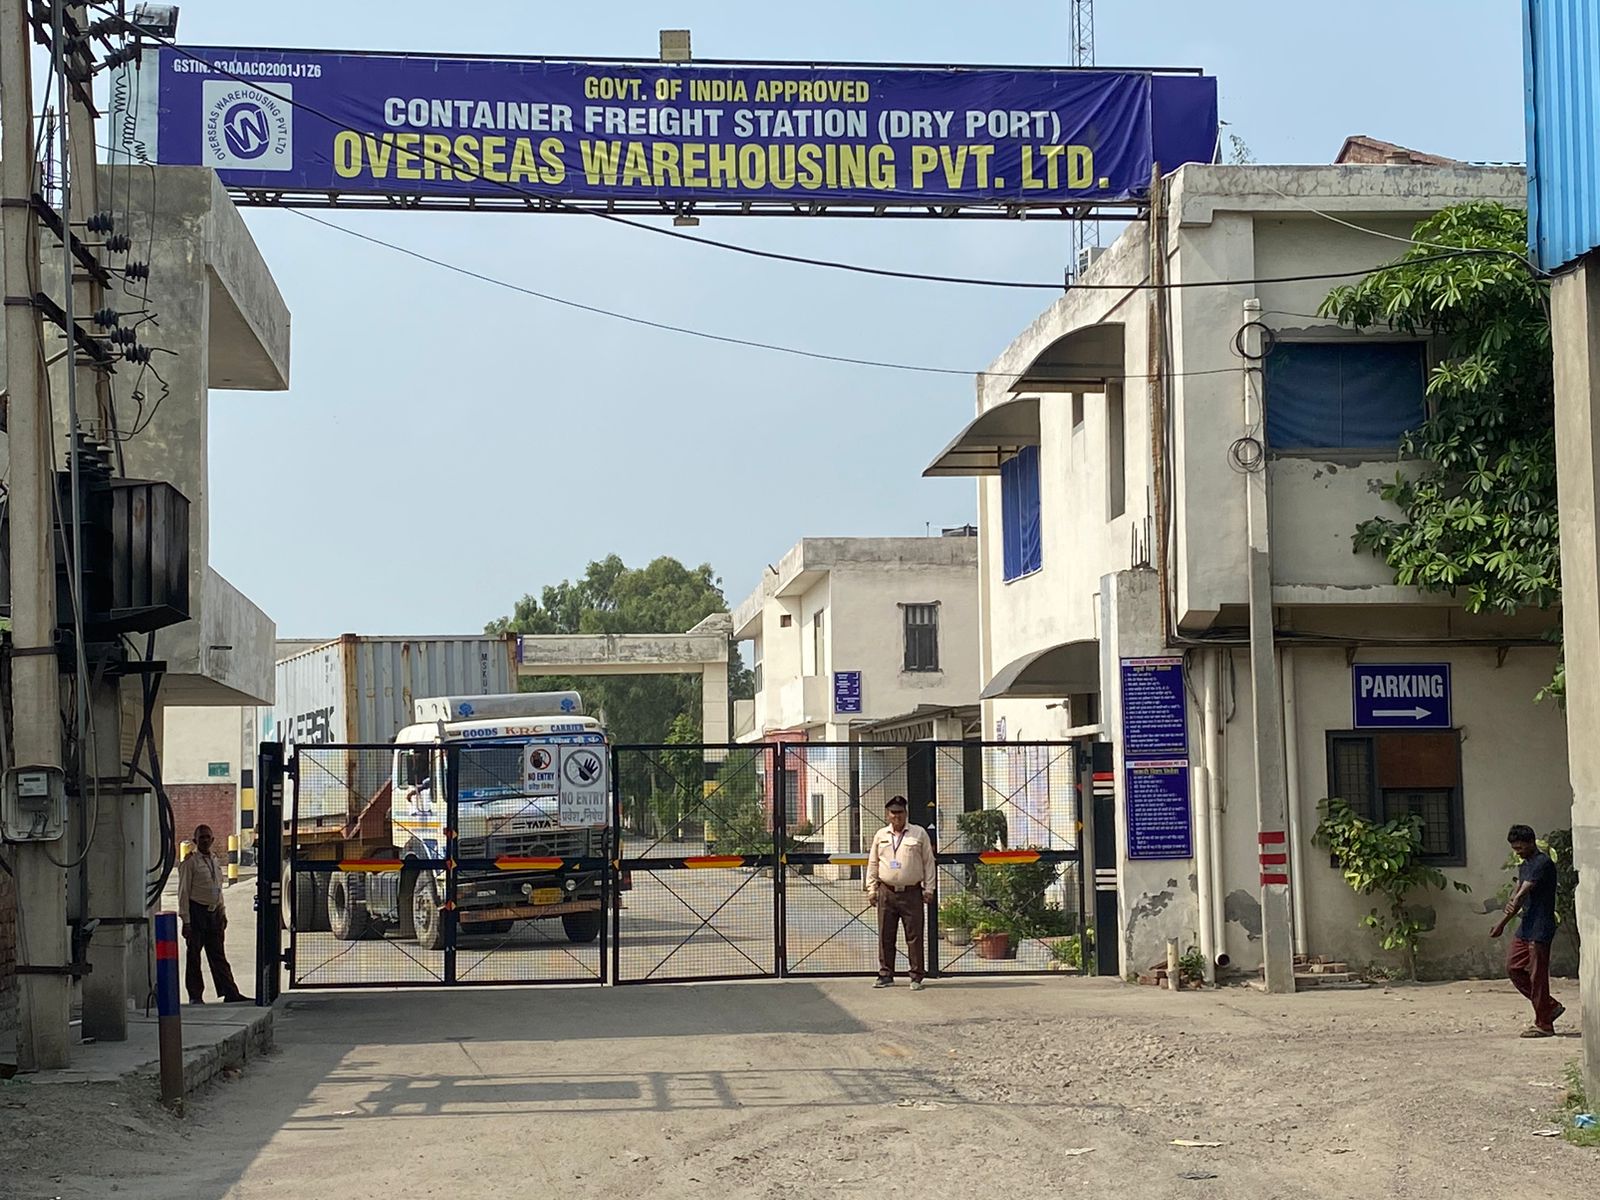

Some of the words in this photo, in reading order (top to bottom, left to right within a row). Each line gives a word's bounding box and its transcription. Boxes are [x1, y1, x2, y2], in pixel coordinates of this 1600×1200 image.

[173, 58, 210, 73] GSTIN.
[584, 76, 647, 100] GOVT.
[655, 78, 682, 100] OF
[690, 80, 748, 102] INDIA
[754, 80, 869, 103] APPROVED
[214, 90, 281, 117] WAREHOUSING
[275, 116, 288, 135] PVT
[384, 97, 574, 133] CONTAINER
[584, 105, 724, 138] FREIGHT
[733, 109, 867, 138] STATION
[878, 110, 954, 144] (DRY
[966, 110, 1061, 144] PORT)
[207, 111, 226, 161] OVERSEAS
[274, 138, 287, 155] LTD
[333, 130, 566, 185] OVERSEAS
[579, 139, 896, 190] WAREHOUSING
[911, 144, 1005, 190] PVT.
[1021, 144, 1110, 190] LTD.
[1360, 674, 1444, 698] PARKING
[462, 728, 498, 738] GOODS
[550, 723, 585, 733] CARRIER
[528, 772, 536, 781] NO
[537, 772, 555, 781] ENTRY
[561, 791, 574, 805] NO
[576, 791, 605, 805] ENTRY
[526, 820, 552, 829] TATA
